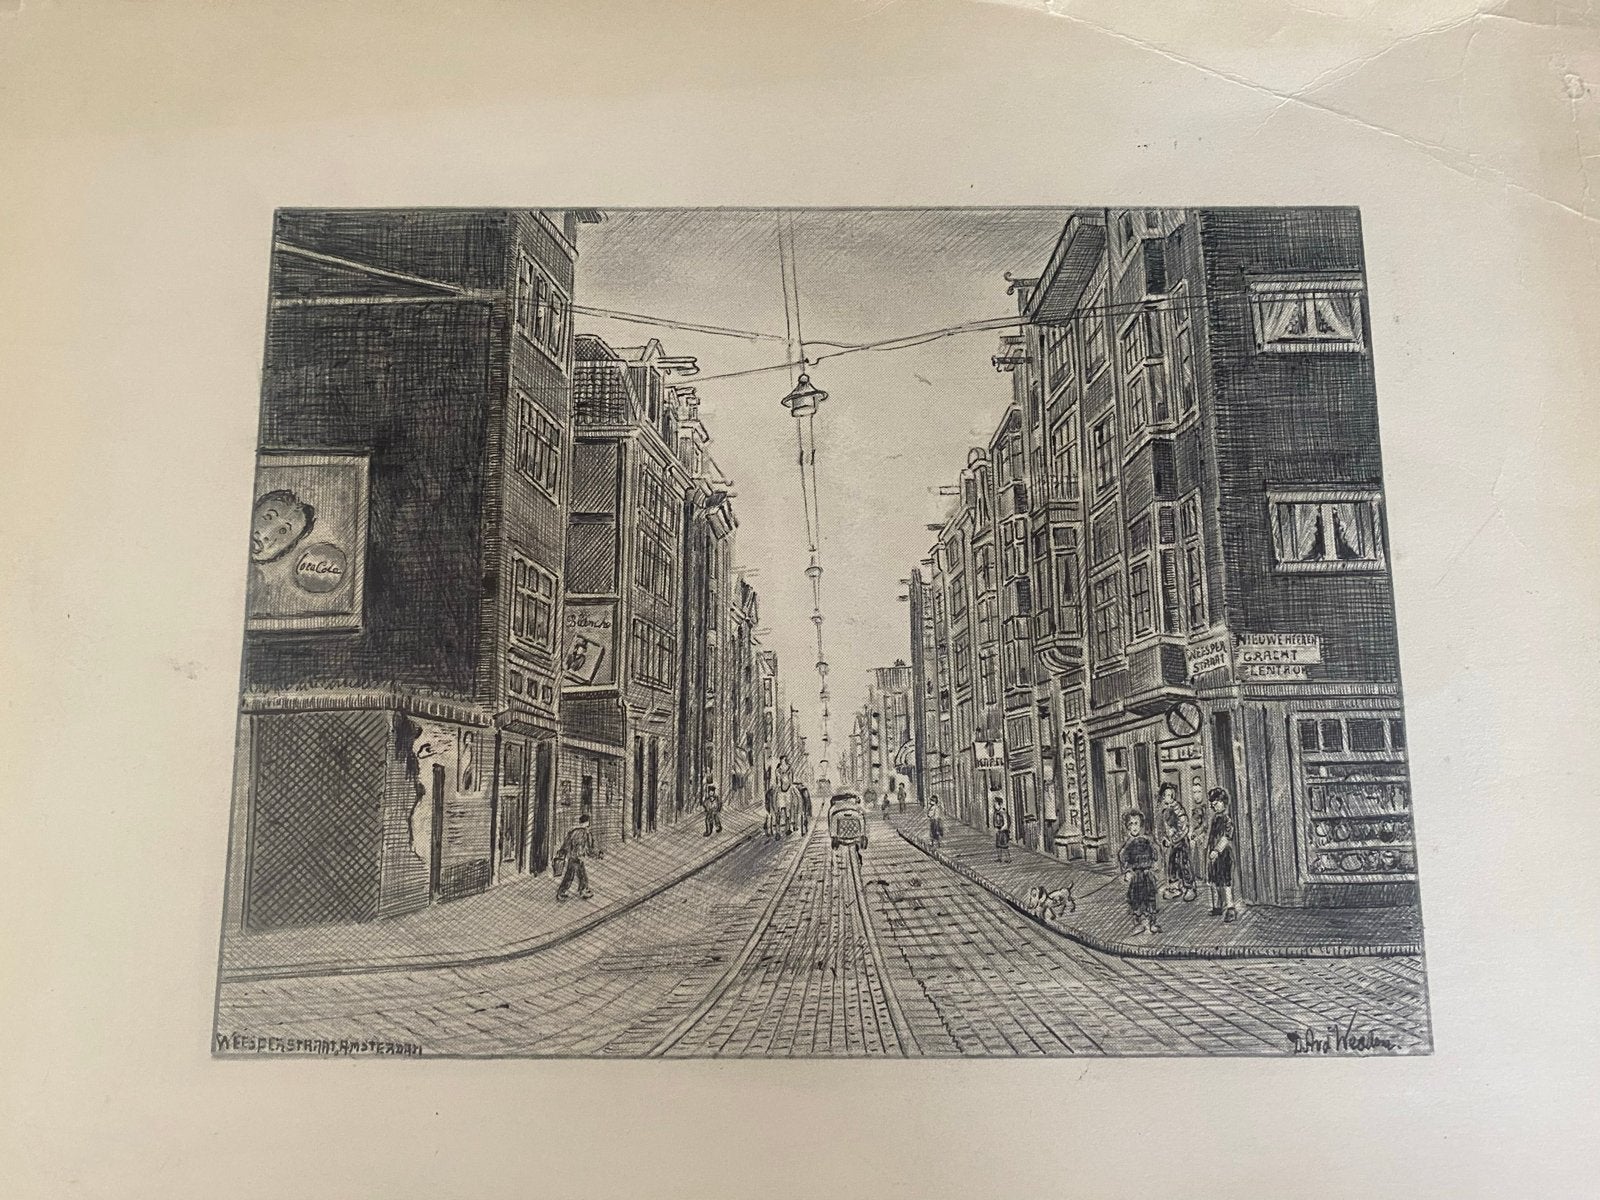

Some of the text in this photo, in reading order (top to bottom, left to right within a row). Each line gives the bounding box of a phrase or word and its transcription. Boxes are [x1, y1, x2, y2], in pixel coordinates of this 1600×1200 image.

[1193, 653, 1225, 673] STRAAT
[1243, 650, 1297, 662] GRACHT
[1062, 731, 1078, 827] KAPPER
